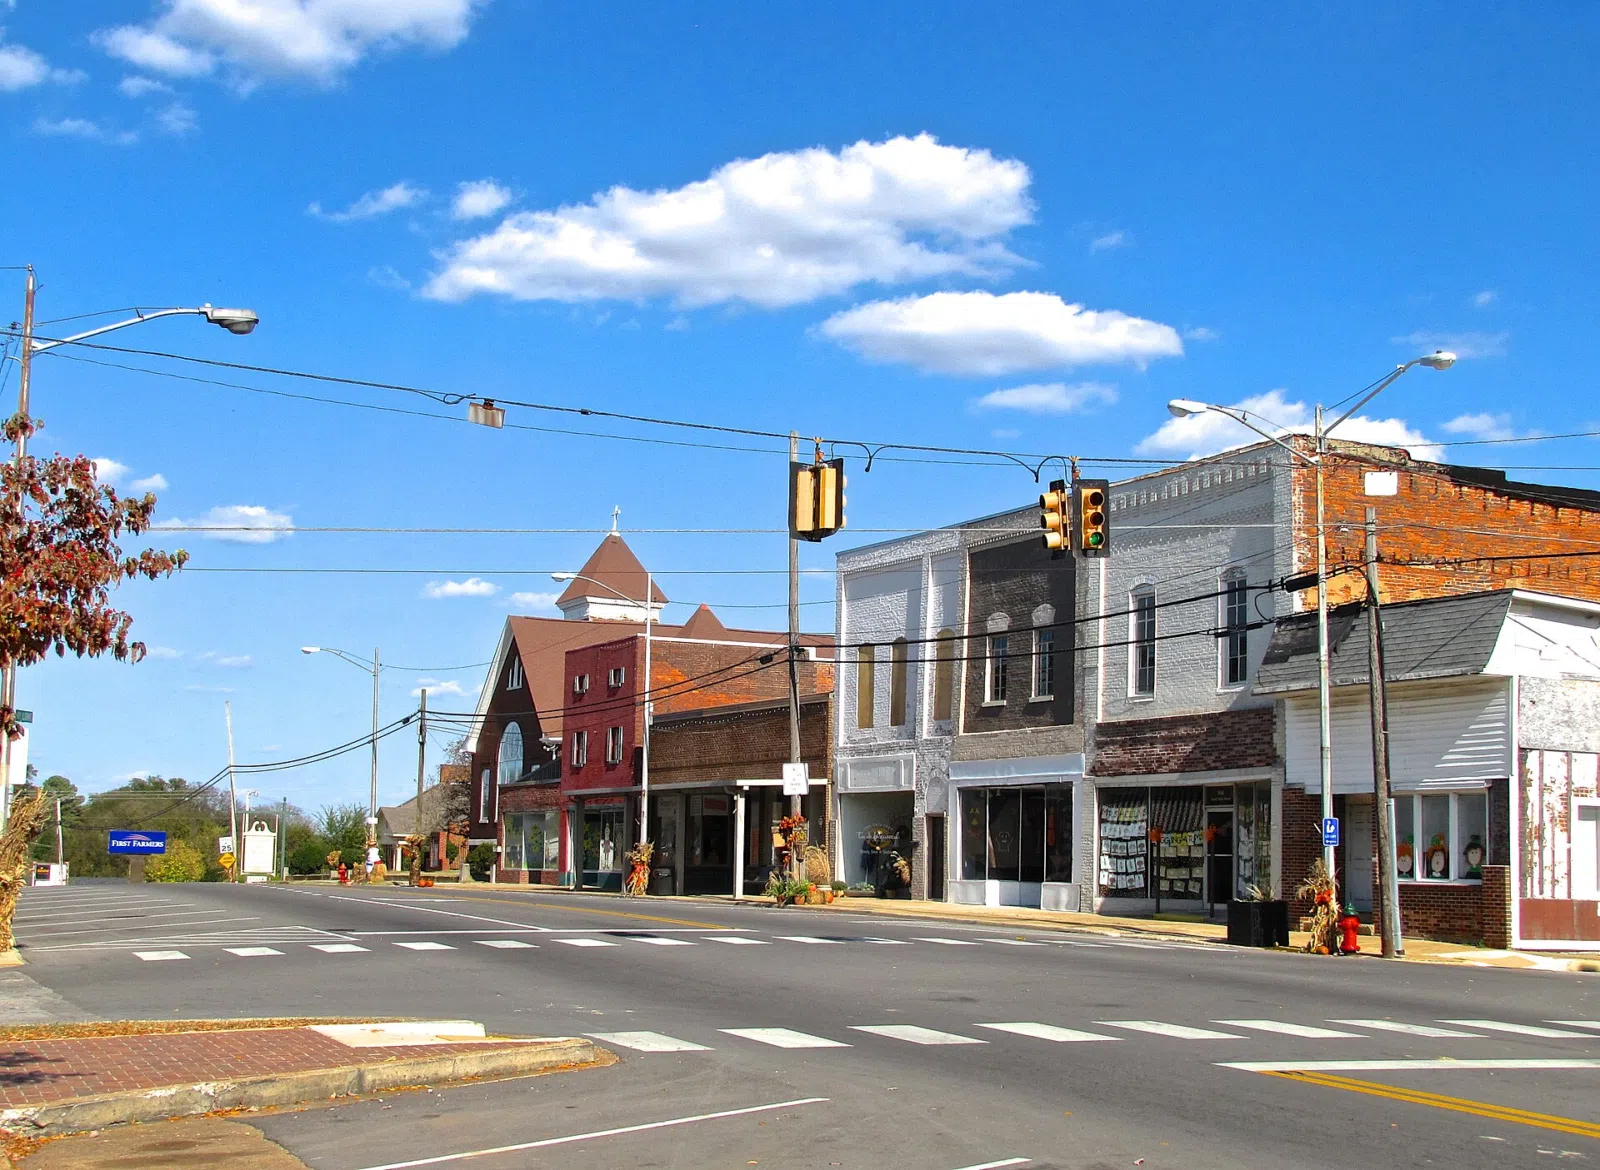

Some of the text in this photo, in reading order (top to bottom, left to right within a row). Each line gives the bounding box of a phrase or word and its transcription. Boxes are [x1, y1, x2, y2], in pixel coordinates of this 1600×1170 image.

[111, 839, 165, 848] FIRST FARMERS
[221, 844, 232, 852] 25
